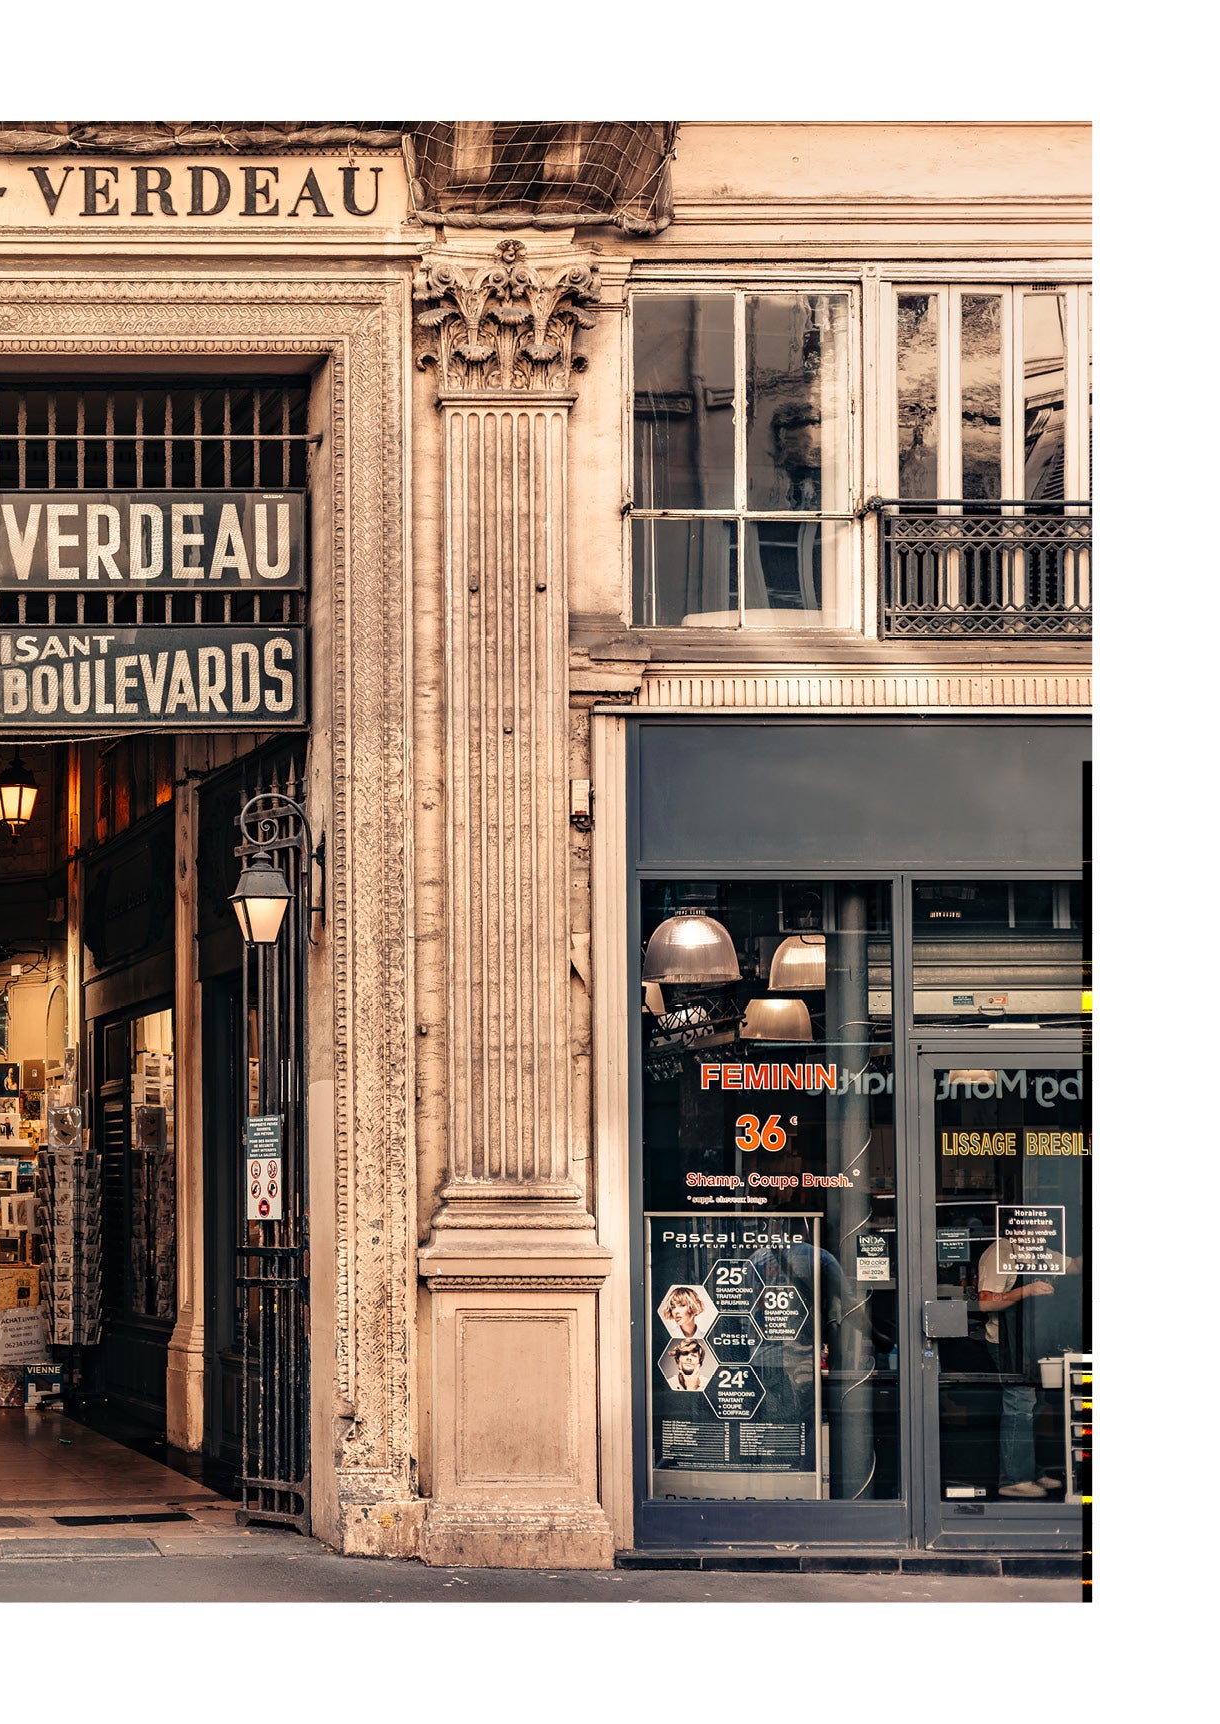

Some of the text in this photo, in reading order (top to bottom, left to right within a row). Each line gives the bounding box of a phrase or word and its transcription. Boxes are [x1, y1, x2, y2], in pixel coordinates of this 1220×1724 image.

[27, 166, 384, 217] VERDEAU
[0, 502, 291, 580] VERDEAU
[2, 637, 294, 715] BOULEVARDS
[700, 1063, 837, 1090] FEMININ
[942, 1132, 1017, 1156] LISSAGE
[686, 1172, 744, 1190] Shamp.
[748, 1173, 799, 1190] Coupe
[1014, 1209, 1047, 1217] Horaires
[663, 1231, 803, 1244] Pascal Coste
[716, 1267, 748, 1285] 25€
[764, 1291, 794, 1309] 36€
[713, 1337, 756, 1346] Coste
[27, 1366, 61, 1374] VIENNE
[718, 1370, 749, 1389] 24€
